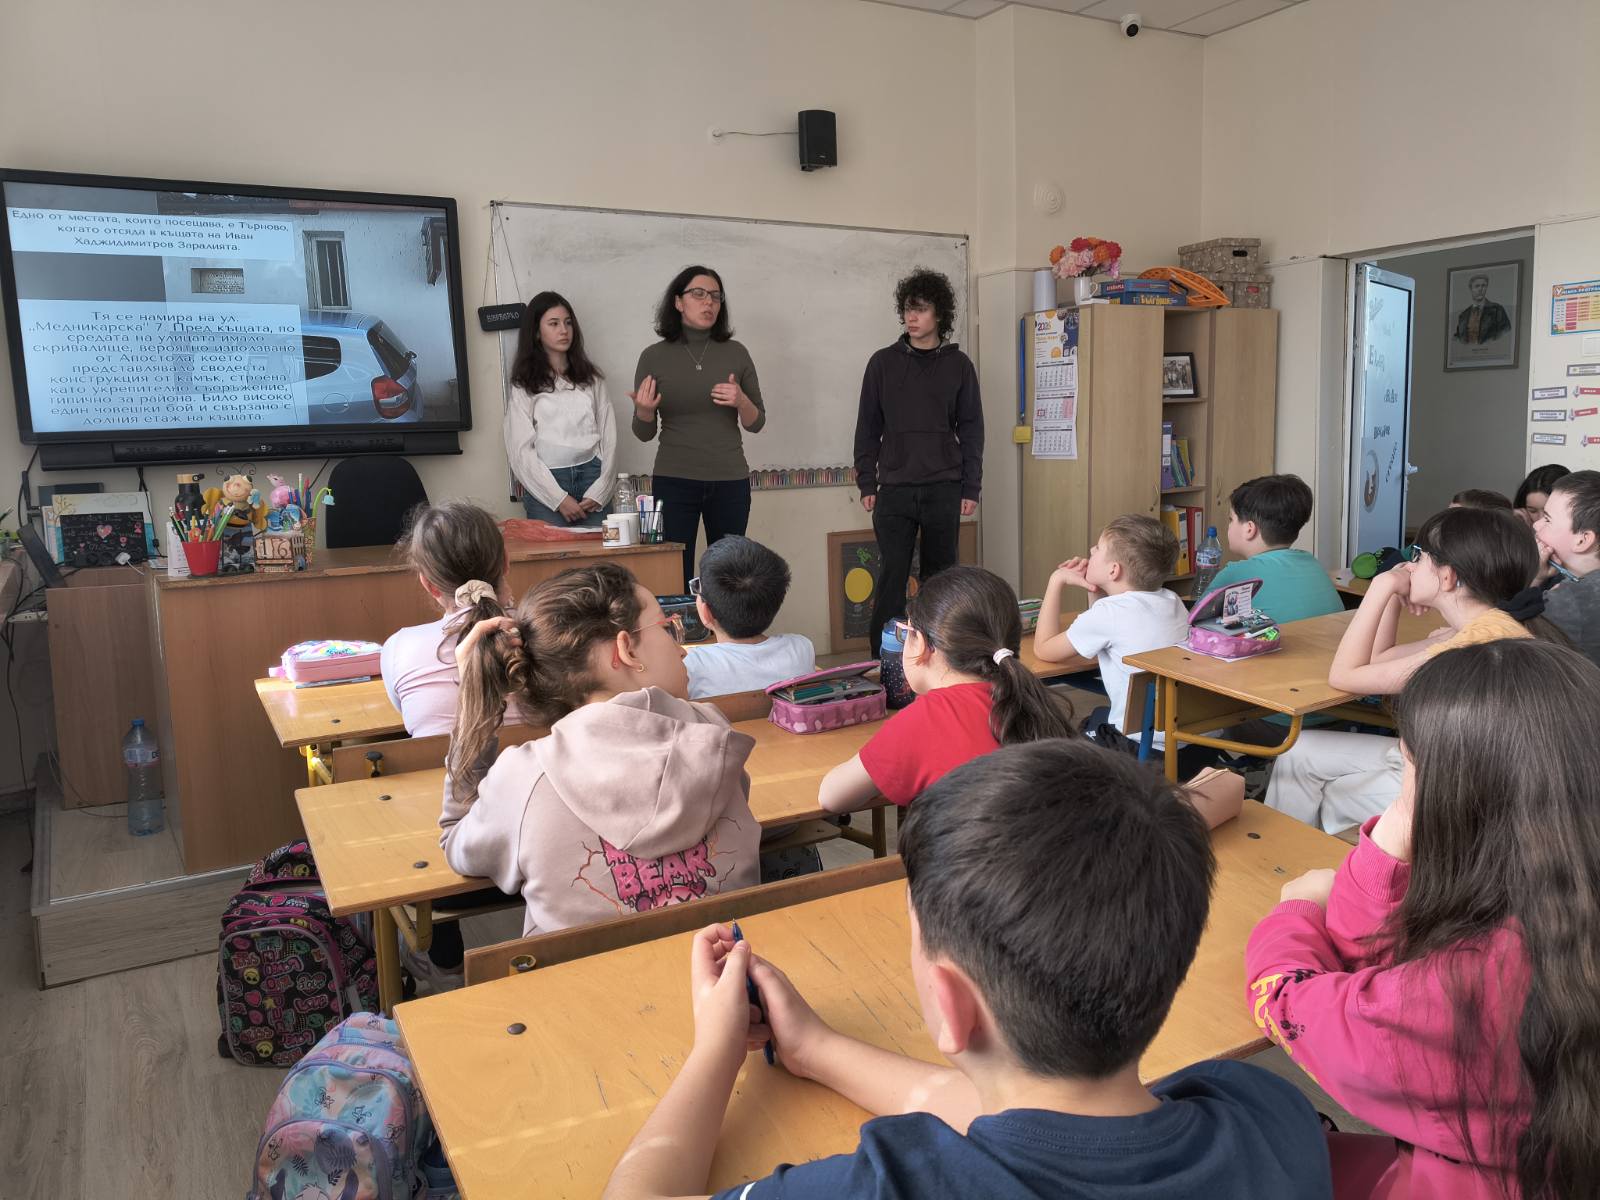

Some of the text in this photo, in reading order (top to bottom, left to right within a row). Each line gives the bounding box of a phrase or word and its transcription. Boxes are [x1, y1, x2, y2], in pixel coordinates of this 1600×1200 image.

[12, 210, 44, 220] Едно
[49, 213, 62, 221] от
[69, 215, 121, 224] местата,
[126, 217, 161, 225] които
[165, 219, 224, 229] посещава,
[239, 222, 289, 232] Търново,
[57, 226, 100, 234] когато
[104, 228, 145, 236] отсяда
[161, 230, 204, 238] къщата
[225, 232, 254, 240] Иван
[74, 237, 241, 251] Хаджидимитров Заралията.
[91, 311, 111, 321] Тя
[139, 314, 193, 324] намира
[220, 315, 239, 325] ул.
[173, 323, 213, 334] Пред
[217, 325, 273, 334] къщата,
[67, 334, 129, 344] средата
[158, 335, 215, 344] улицата
[33, 344, 296, 355] скривалище, вероятно използвано
[96, 355, 113, 363] от
[120, 354, 195, 363] Апостола,
[72, 365, 266, 375] представлявало сводеста
[50, 376, 149, 386] конструкция
[230, 375, 287, 384] строена
[50, 384, 289, 396] като укрепително съоръжение,
[50, 396, 112, 405] типично
[202, 394, 238, 402] Било
[243, 394, 293, 402] високо
[51, 408, 89, 416] един
[94, 406, 160, 414] човешки
[166, 404, 193, 413] бой
[213, 403, 279, 413] свързано
[83, 417, 138, 425] долния
[144, 415, 181, 423] етаж
[260, 539, 288, 558] 16
[611, 840, 717, 907] BEAR
